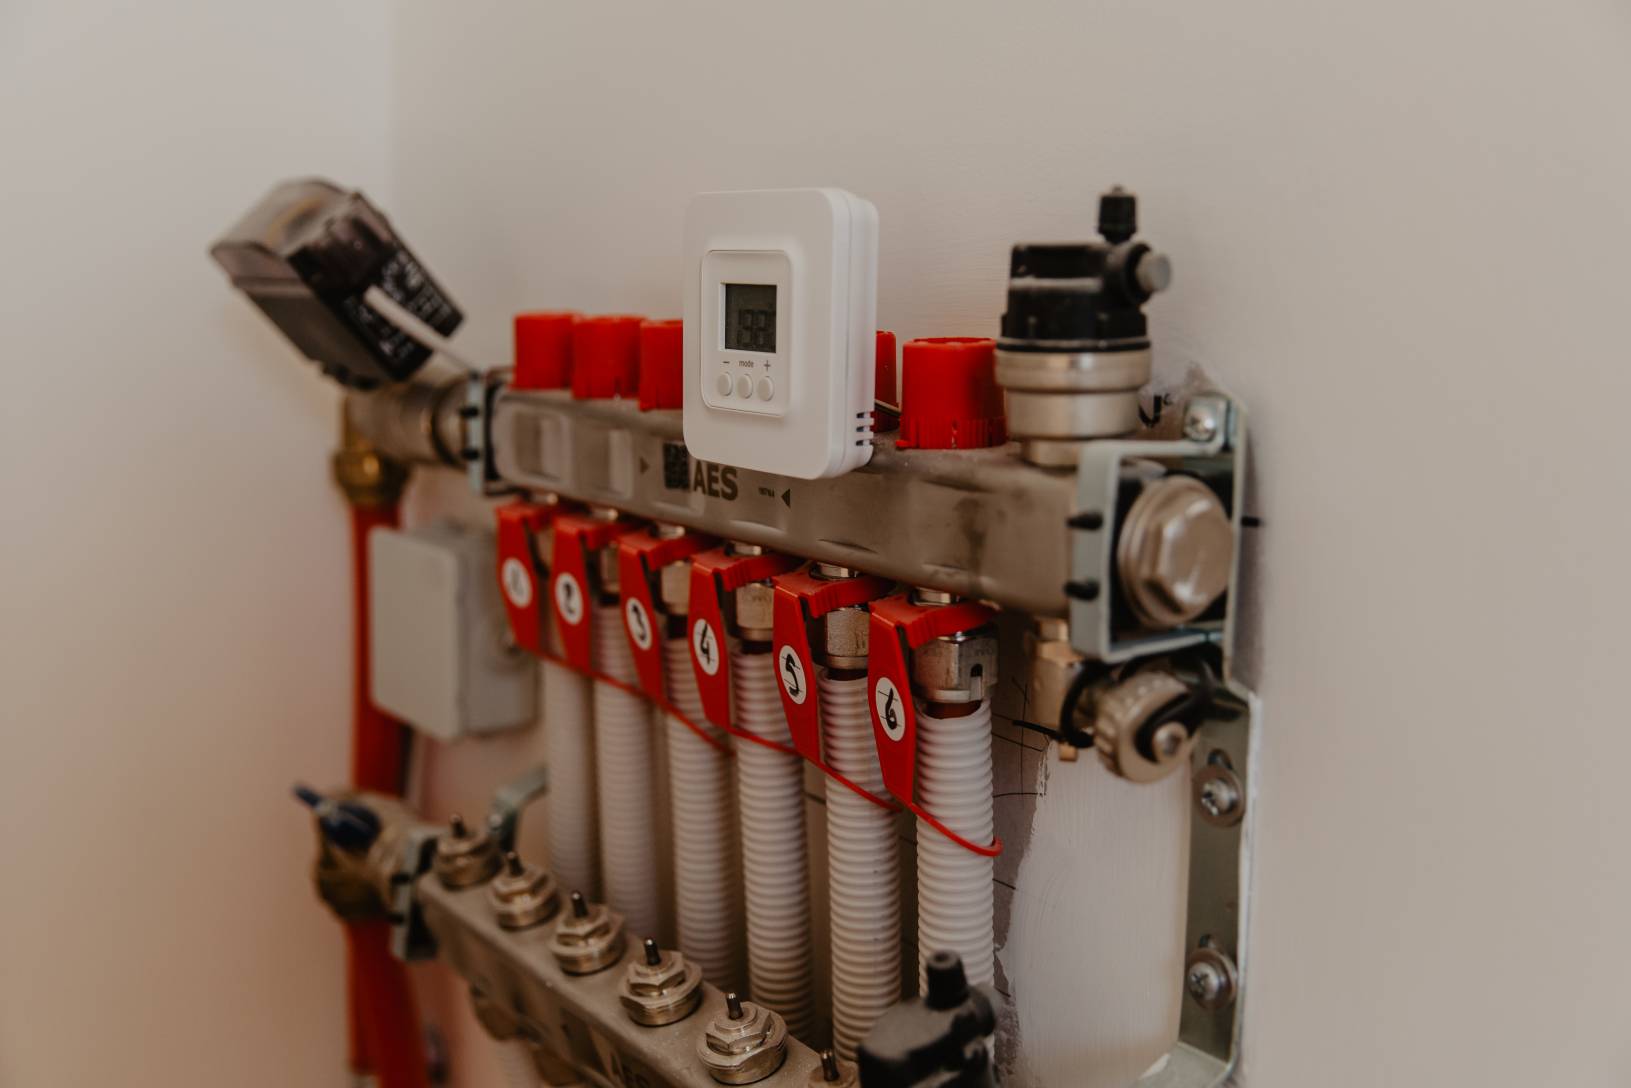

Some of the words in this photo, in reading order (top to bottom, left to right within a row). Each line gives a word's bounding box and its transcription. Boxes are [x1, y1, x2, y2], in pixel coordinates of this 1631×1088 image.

[738, 360, 754, 368] mode
[693, 459, 738, 501] AES
[563, 582, 576, 614] 2
[631, 604, 647, 640] 3
[700, 623, 712, 664] 4
[785, 653, 800, 696] 5
[884, 687, 899, 730] 6
